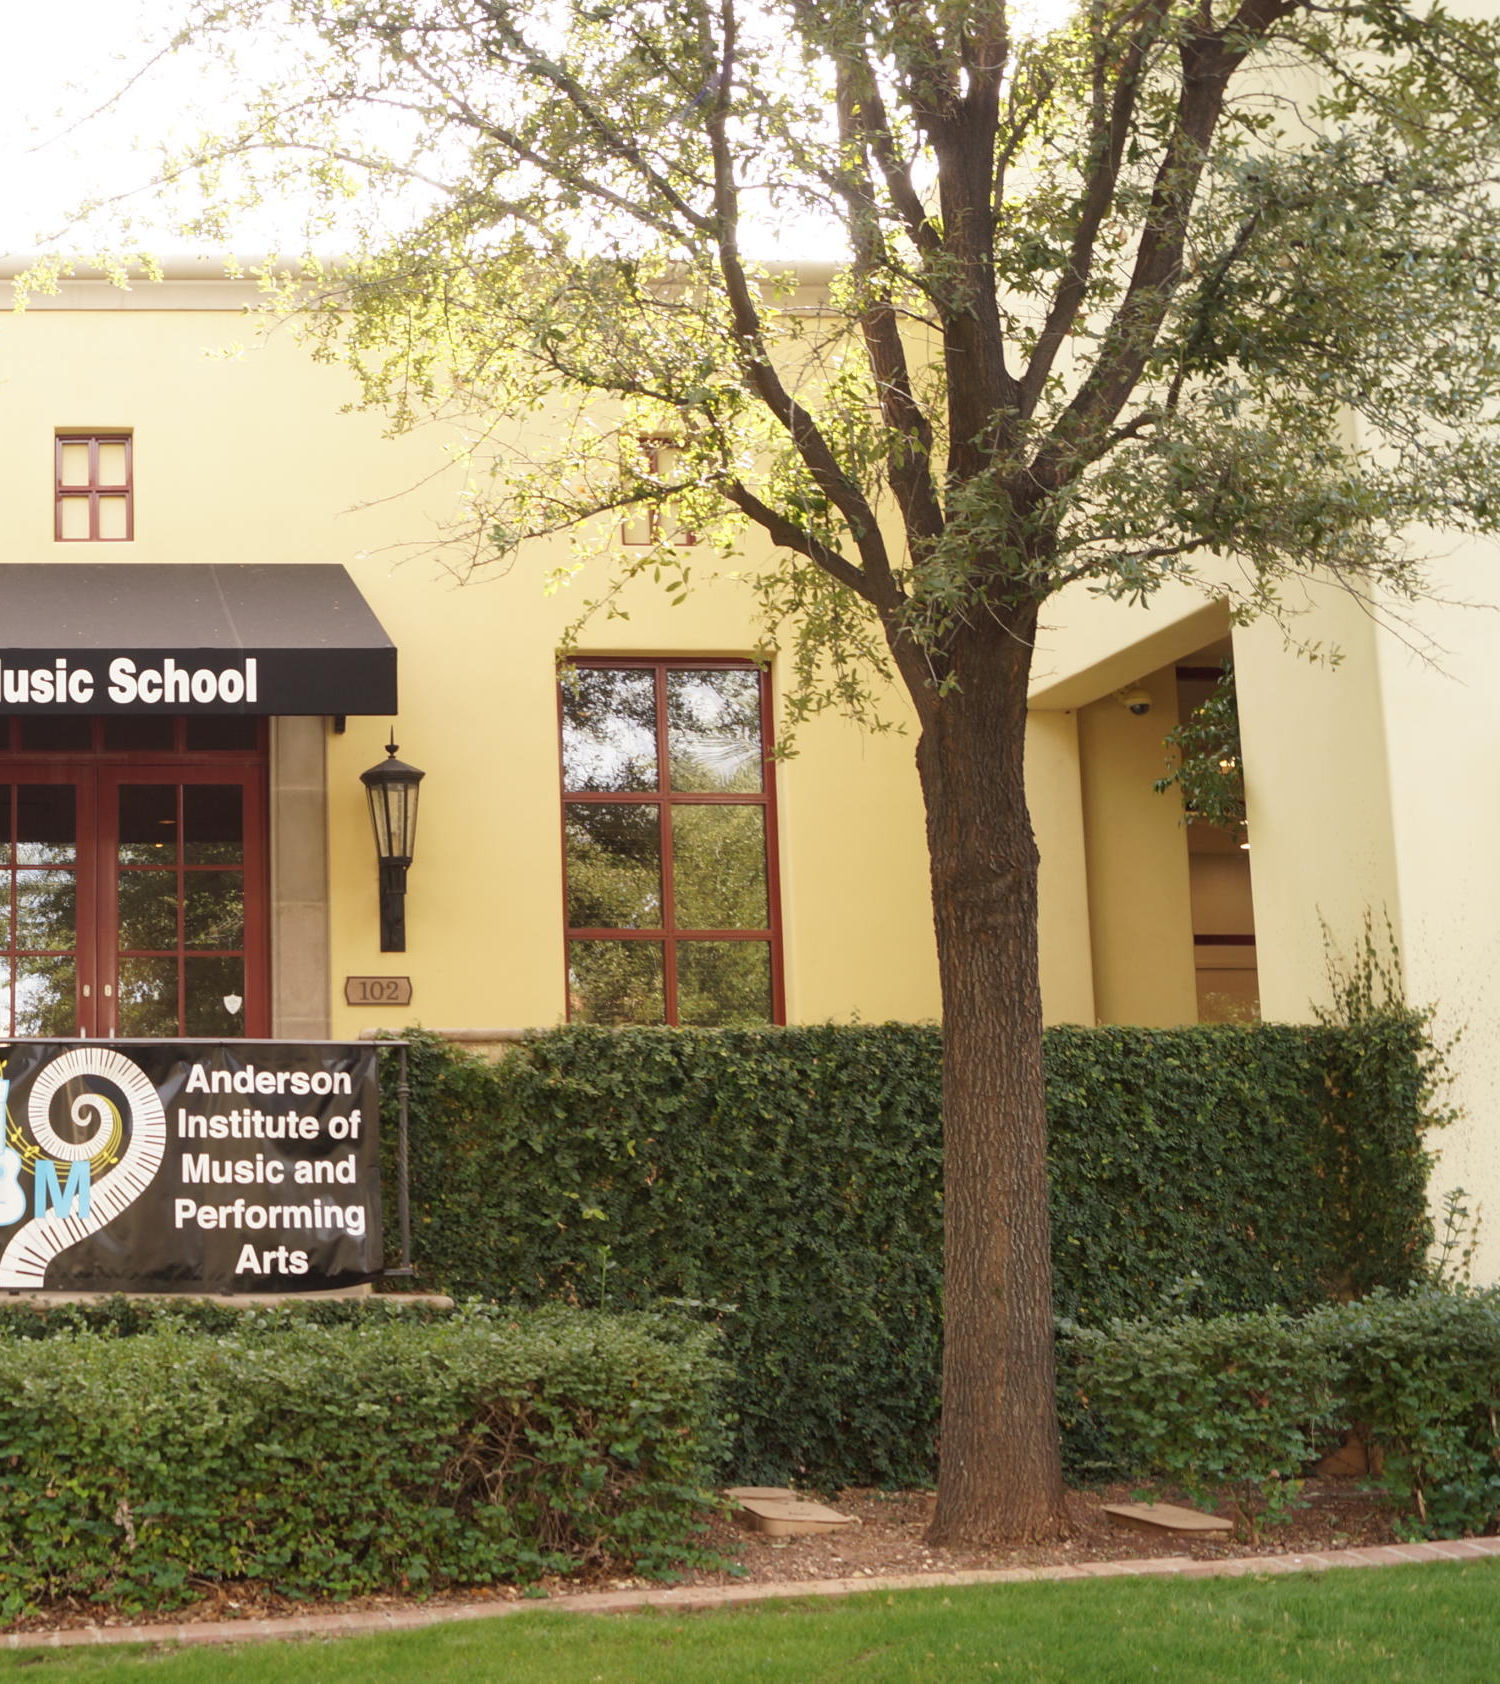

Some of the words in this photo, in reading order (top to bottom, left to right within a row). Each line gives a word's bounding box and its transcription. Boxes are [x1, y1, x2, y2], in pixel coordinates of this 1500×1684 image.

[107, 657, 257, 704] School
[359, 980, 399, 1001] 102
[185, 1063, 352, 1095] Anderson
[178, 1108, 320, 1140] Institute
[328, 1109, 361, 1140] of
[182, 1153, 285, 1184] Music
[293, 1154, 357, 1185] and
[174, 1198, 366, 1237] Performing
[235, 1244, 309, 1275] Arts
